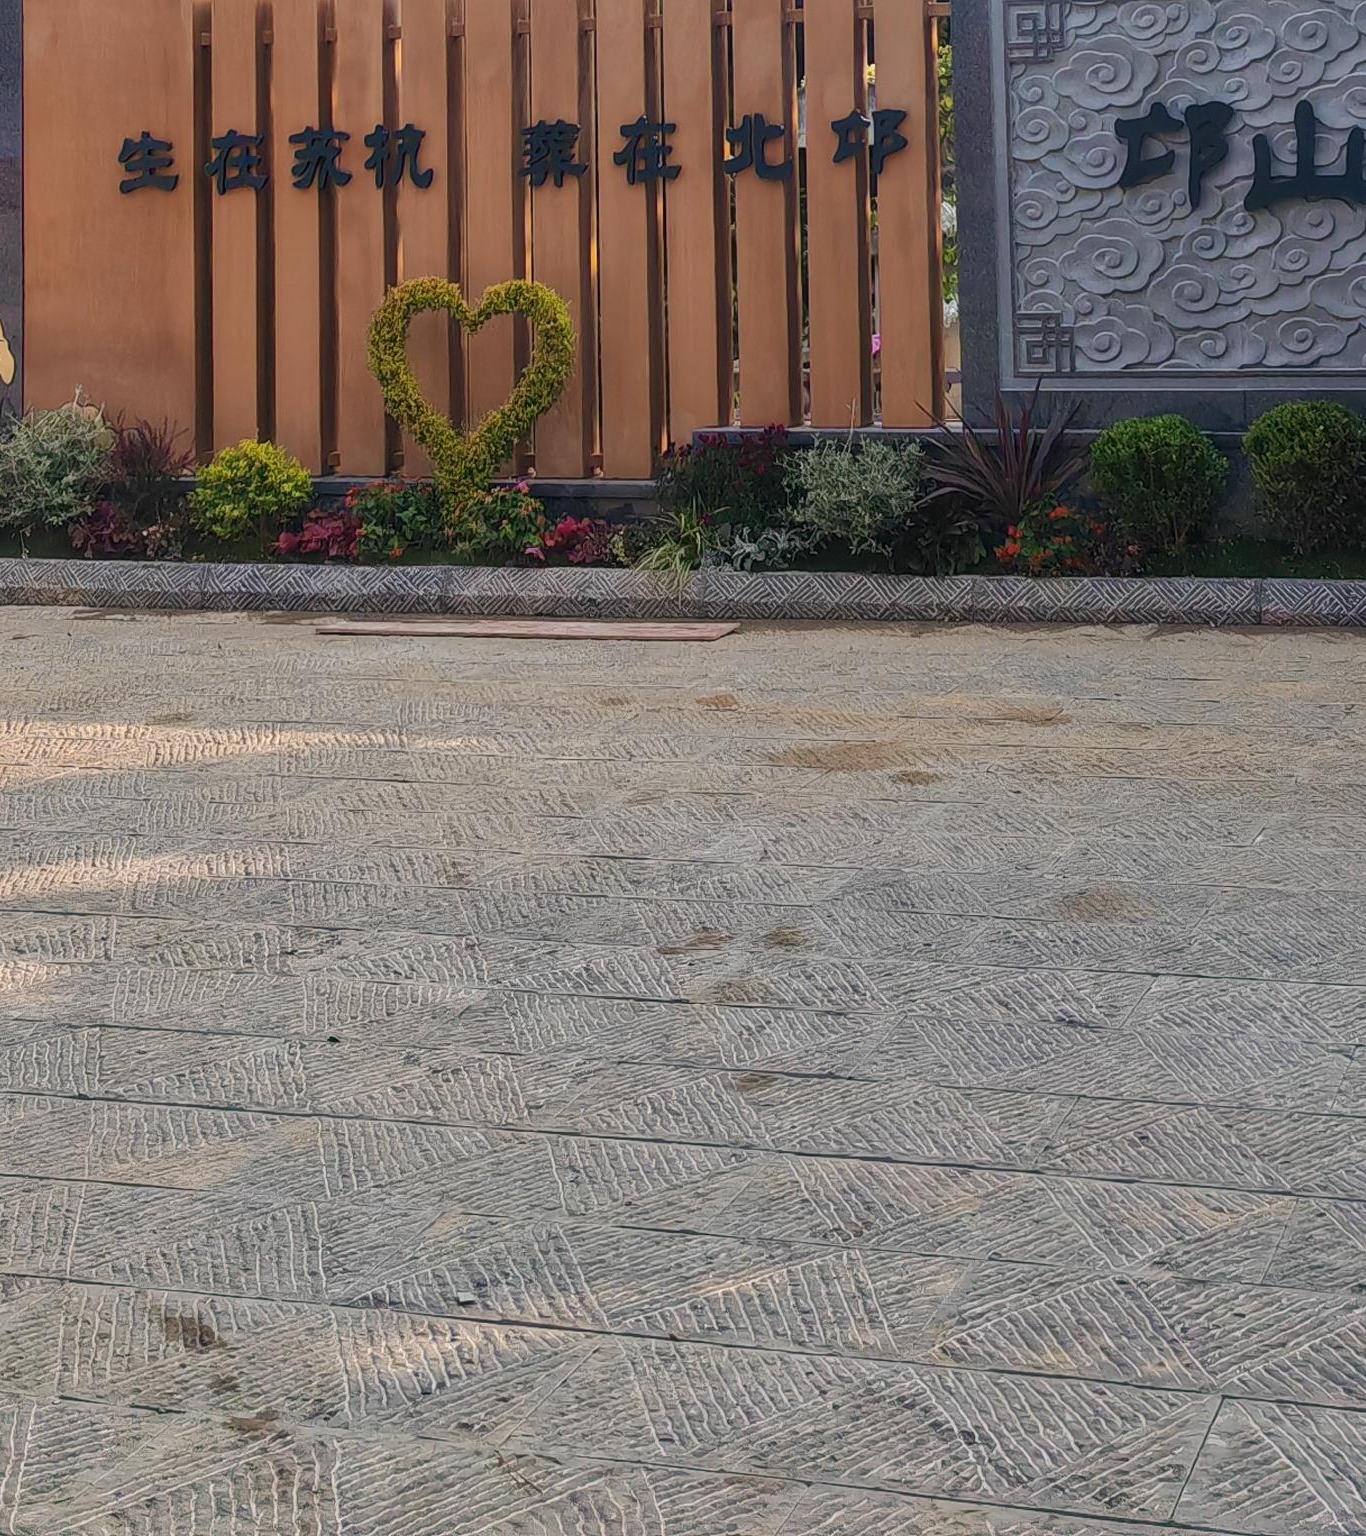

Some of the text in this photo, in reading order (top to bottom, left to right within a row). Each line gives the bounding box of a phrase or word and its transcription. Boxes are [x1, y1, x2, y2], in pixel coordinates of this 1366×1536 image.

[118, 108, 908, 196] 生在苏杭 葬在北邙
